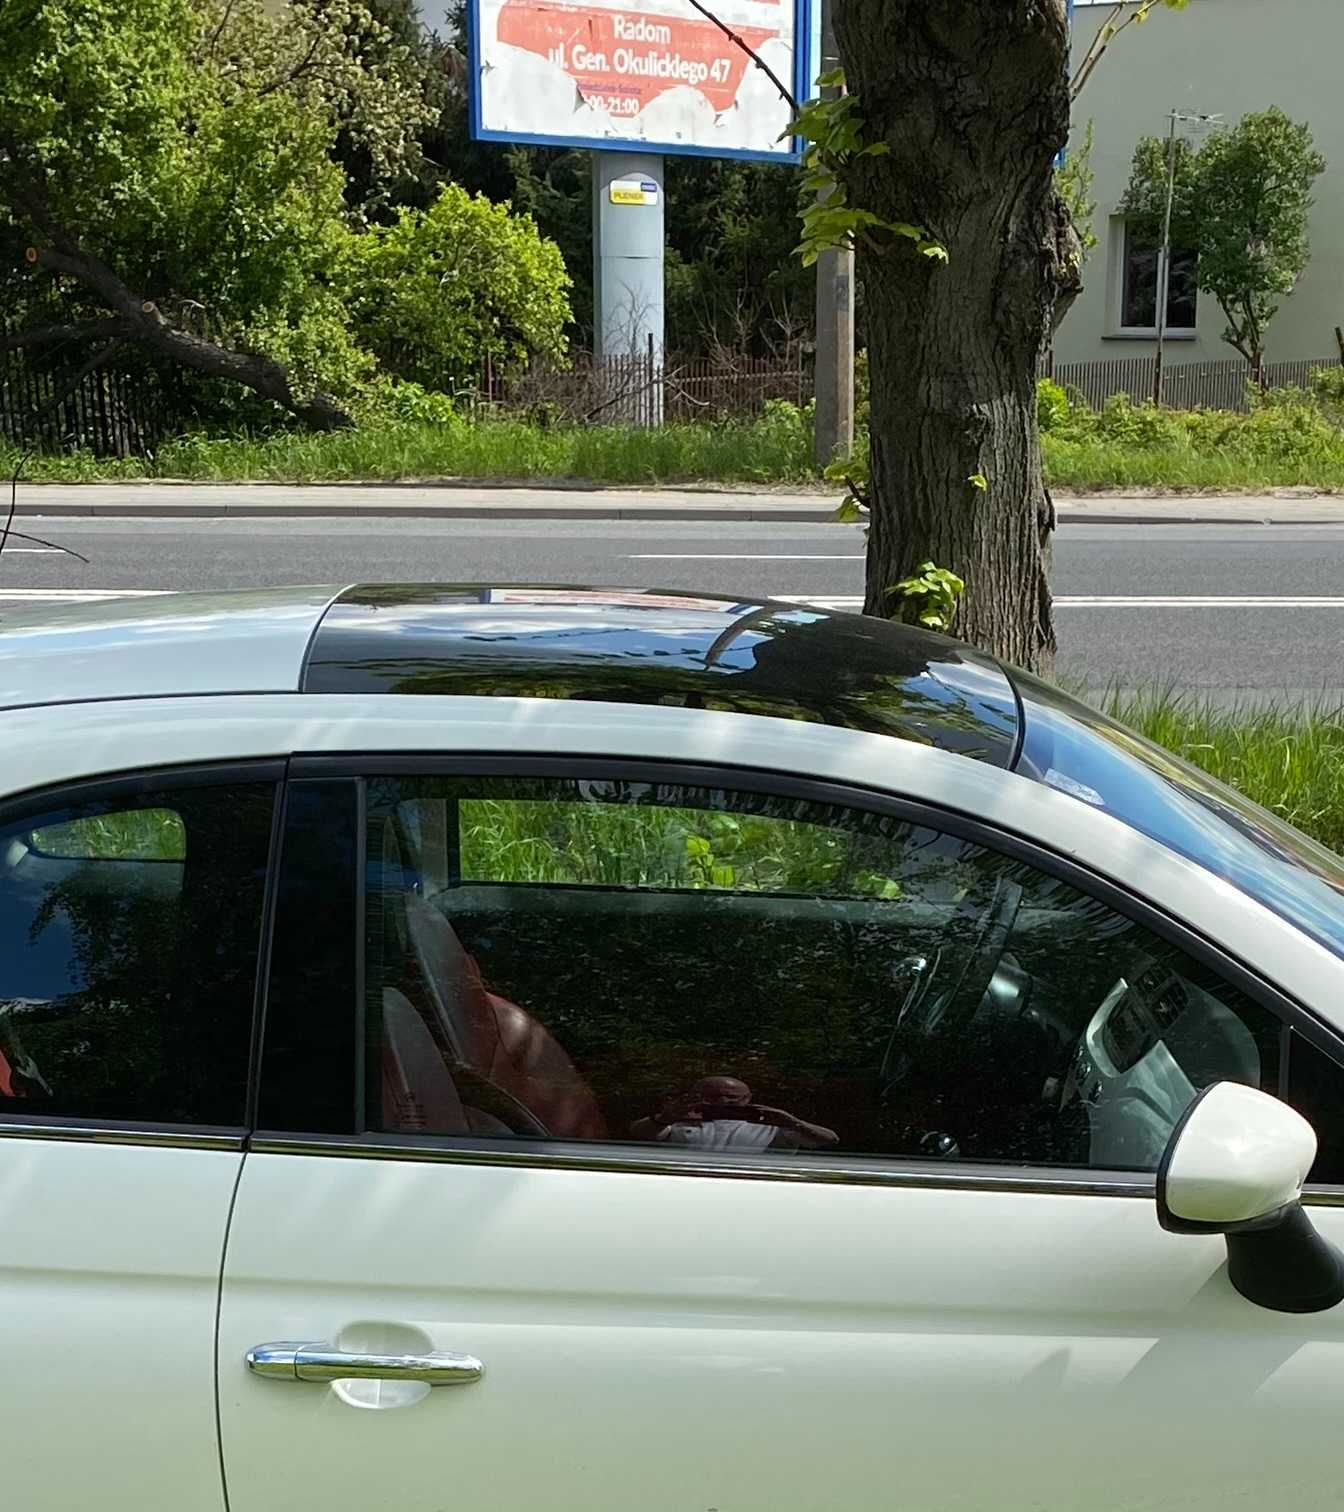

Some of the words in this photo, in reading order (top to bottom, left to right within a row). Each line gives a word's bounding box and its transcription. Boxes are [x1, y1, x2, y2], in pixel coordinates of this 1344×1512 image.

[613, 14, 671, 44] Radom
[548, 42, 569, 69] ul.
[572, 44, 611, 72] Gen.
[613, 48, 709, 85] Okulickiego
[710, 58, 731, 83] 47
